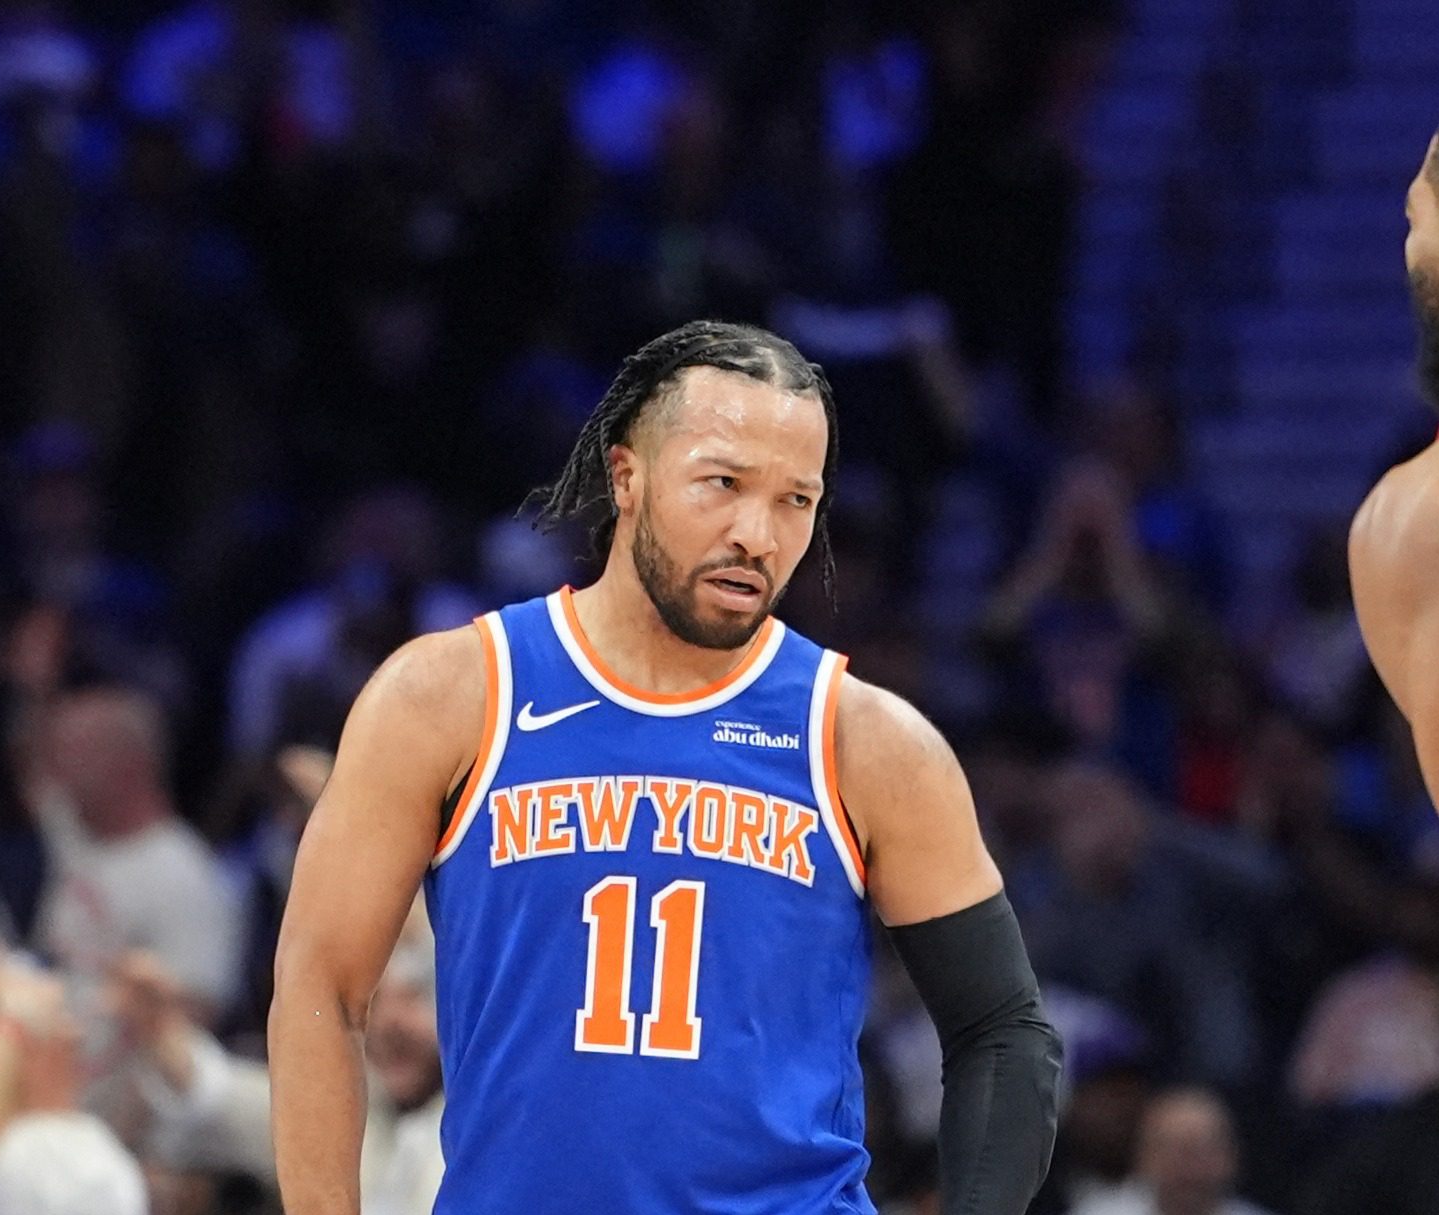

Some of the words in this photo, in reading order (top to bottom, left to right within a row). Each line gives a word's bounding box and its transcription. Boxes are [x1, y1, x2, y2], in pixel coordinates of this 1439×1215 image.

[713, 728, 747, 745] abu
[748, 731, 800, 750] dhabi
[488, 775, 644, 868] NEW
[644, 775, 819, 888] YORK
[574, 875, 706, 1060] 11
